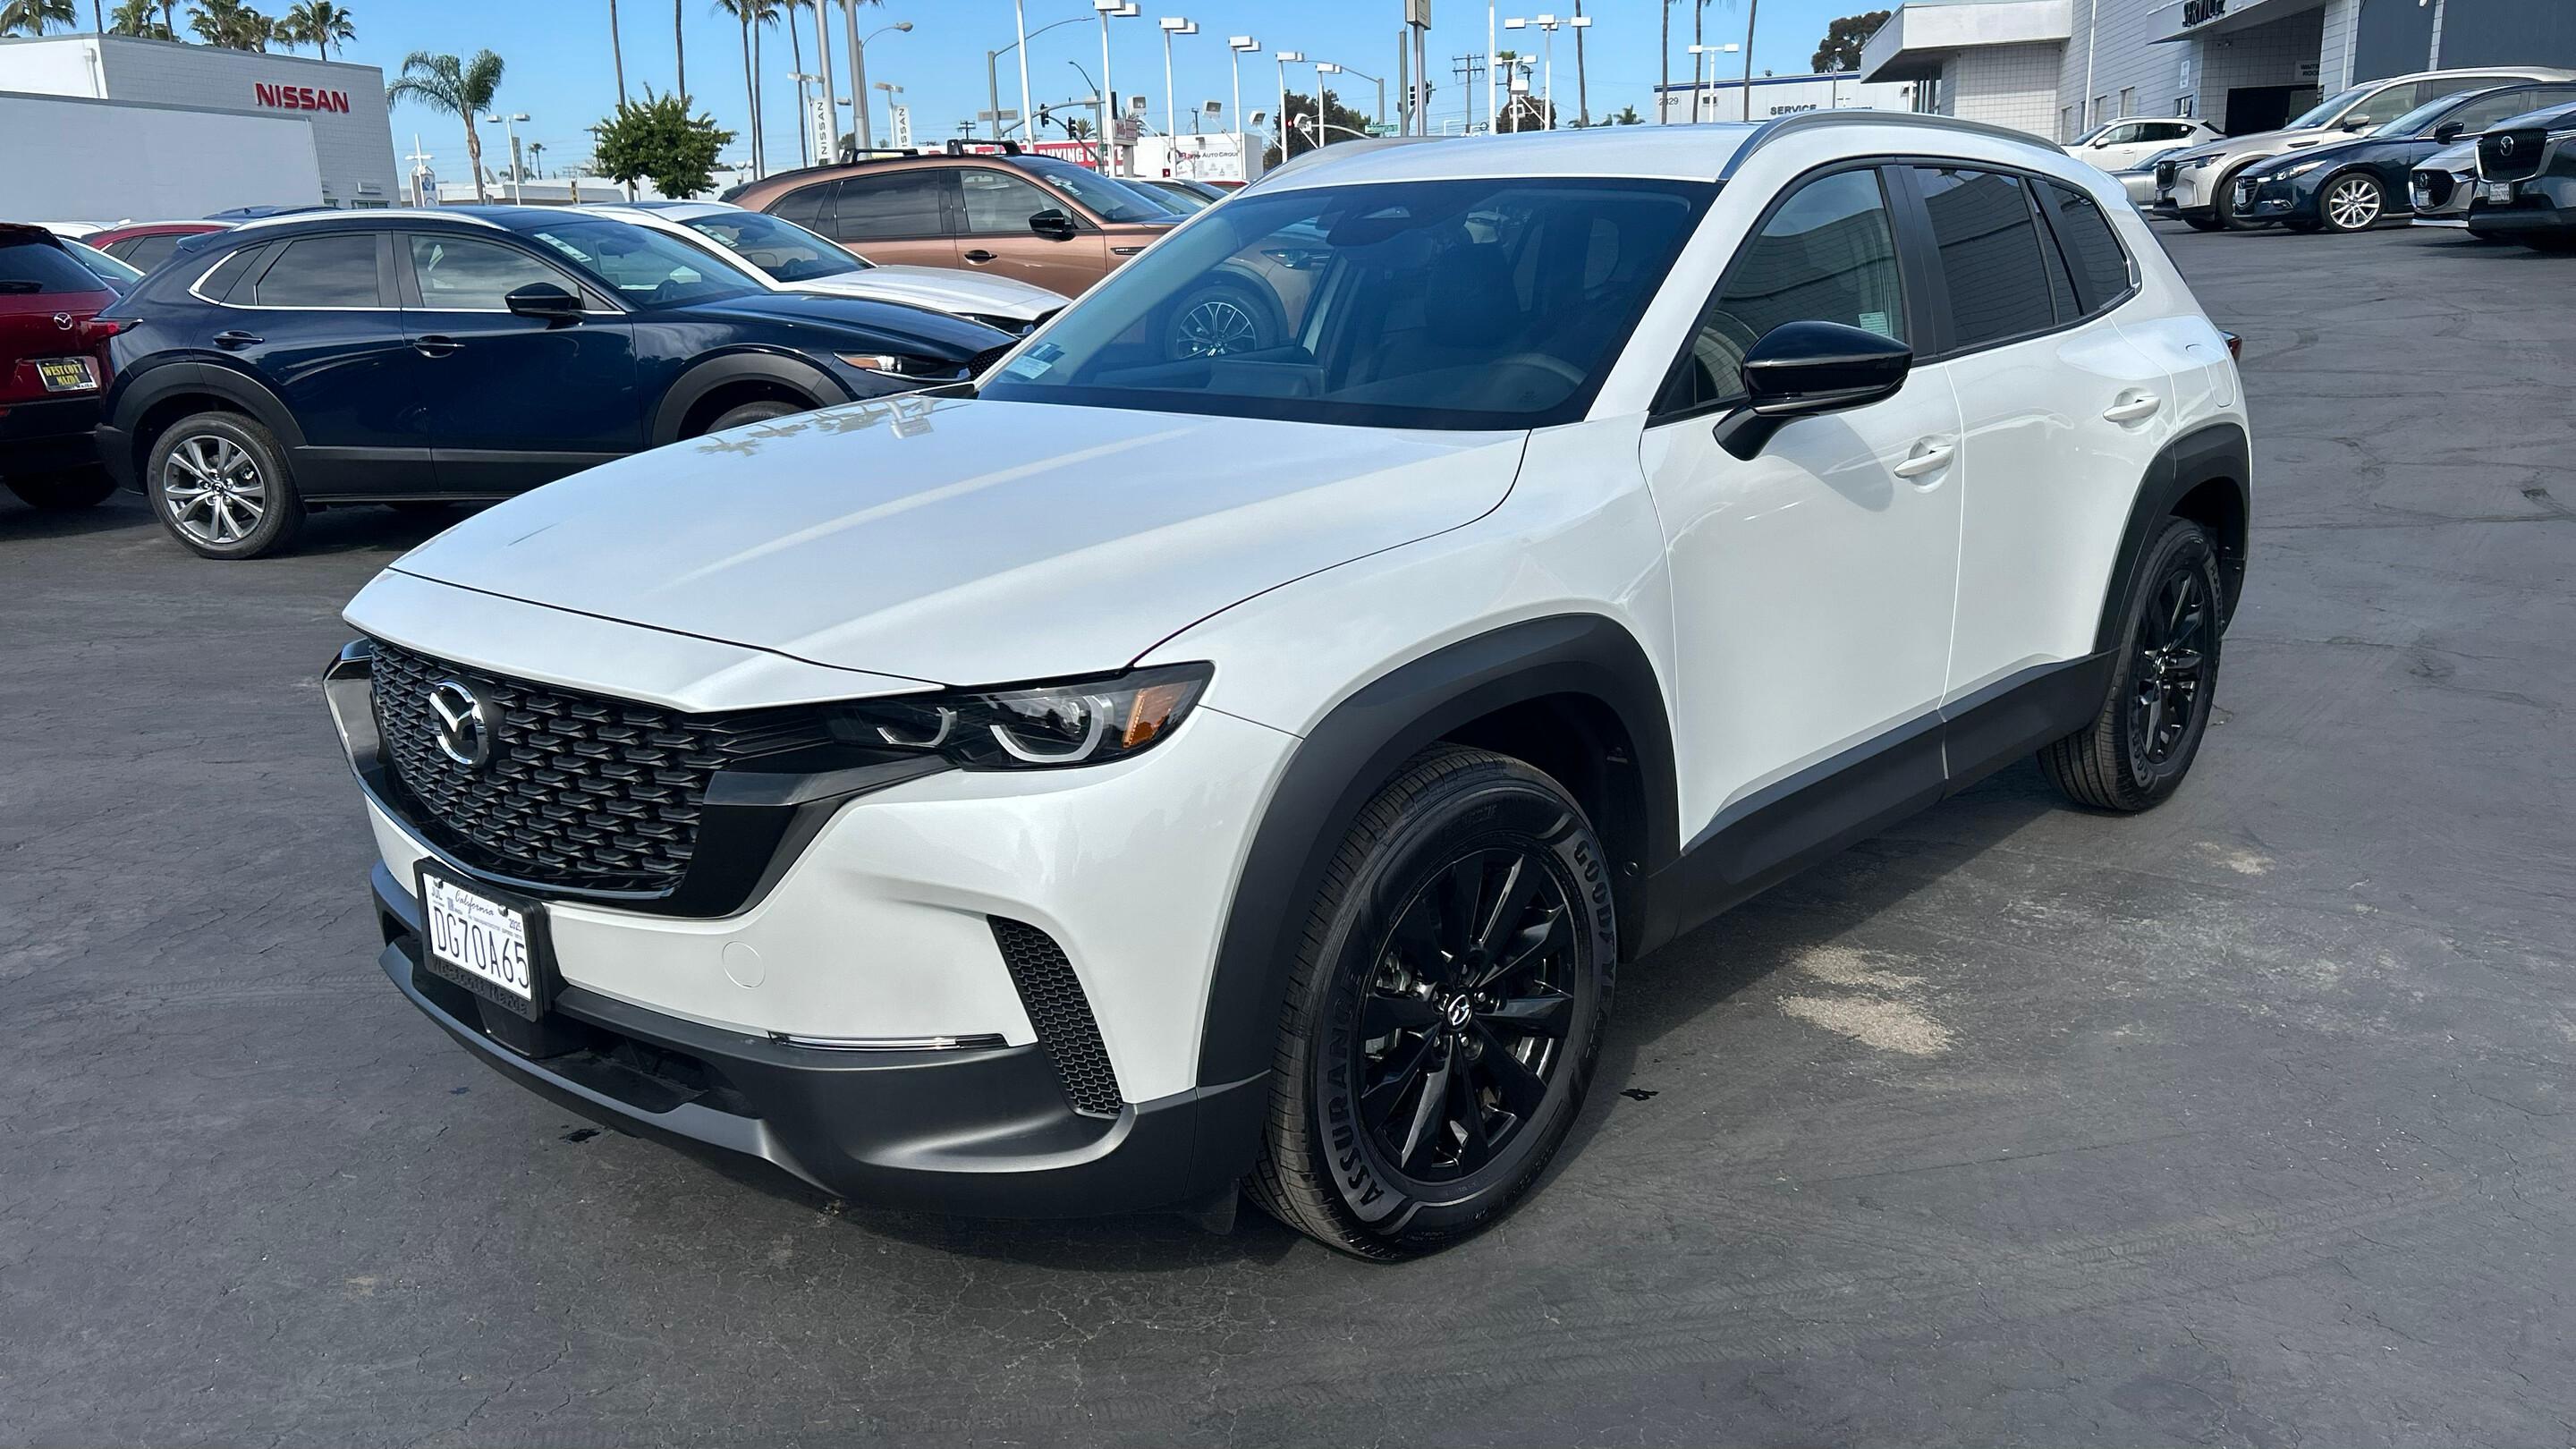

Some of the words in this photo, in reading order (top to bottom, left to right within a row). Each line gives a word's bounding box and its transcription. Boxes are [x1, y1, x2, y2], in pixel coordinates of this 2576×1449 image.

[2182, 0, 2225, 27] SERVICE
[256, 82, 350, 113] NISSAN
[1658, 97, 1679, 106] 229
[1769, 104, 1817, 115] SERVICE
[817, 101, 828, 155] NISSAN
[898, 107, 909, 148] ISSAN
[454, 889, 495, 915] California
[434, 905, 530, 989] DG70A65
[1326, 964, 1385, 1207] ASSURANCE
